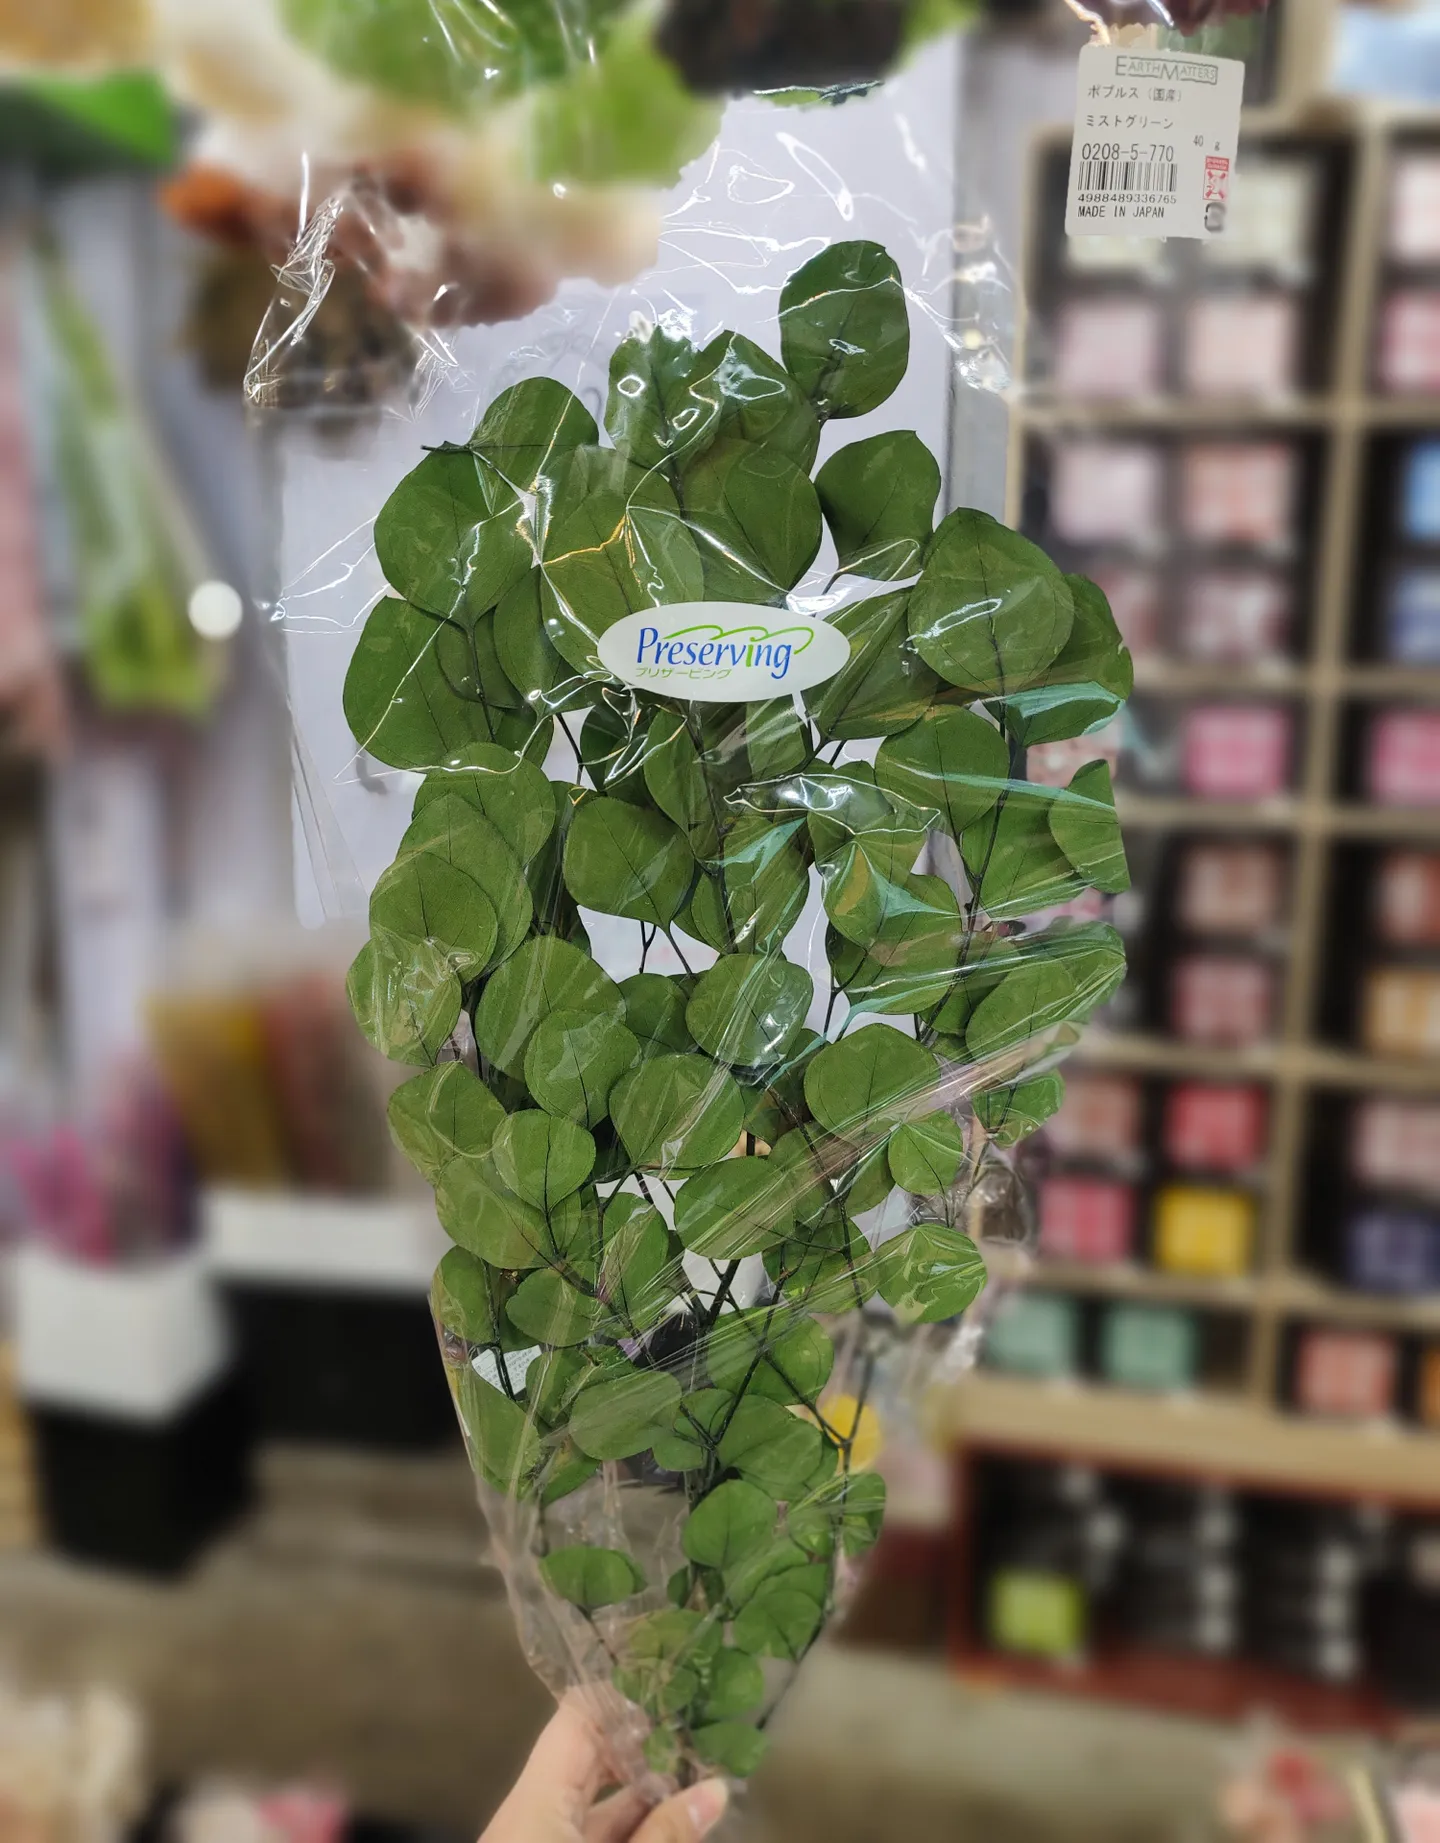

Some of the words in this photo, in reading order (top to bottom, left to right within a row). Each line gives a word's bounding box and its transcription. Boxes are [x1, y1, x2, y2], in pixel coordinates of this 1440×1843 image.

[1086, 114, 1174, 130] ミストグリーン
[1193, 135, 1204, 147] 40
[1082, 143, 1174, 162] 0208-5-770
[1078, 193, 1177, 204] 4988489336765
[1078, 206, 1105, 218] MADE
[1114, 206, 1126, 218] IN
[1133, 207, 1165, 218] JAPAN
[637, 627, 793, 680] Preserving
